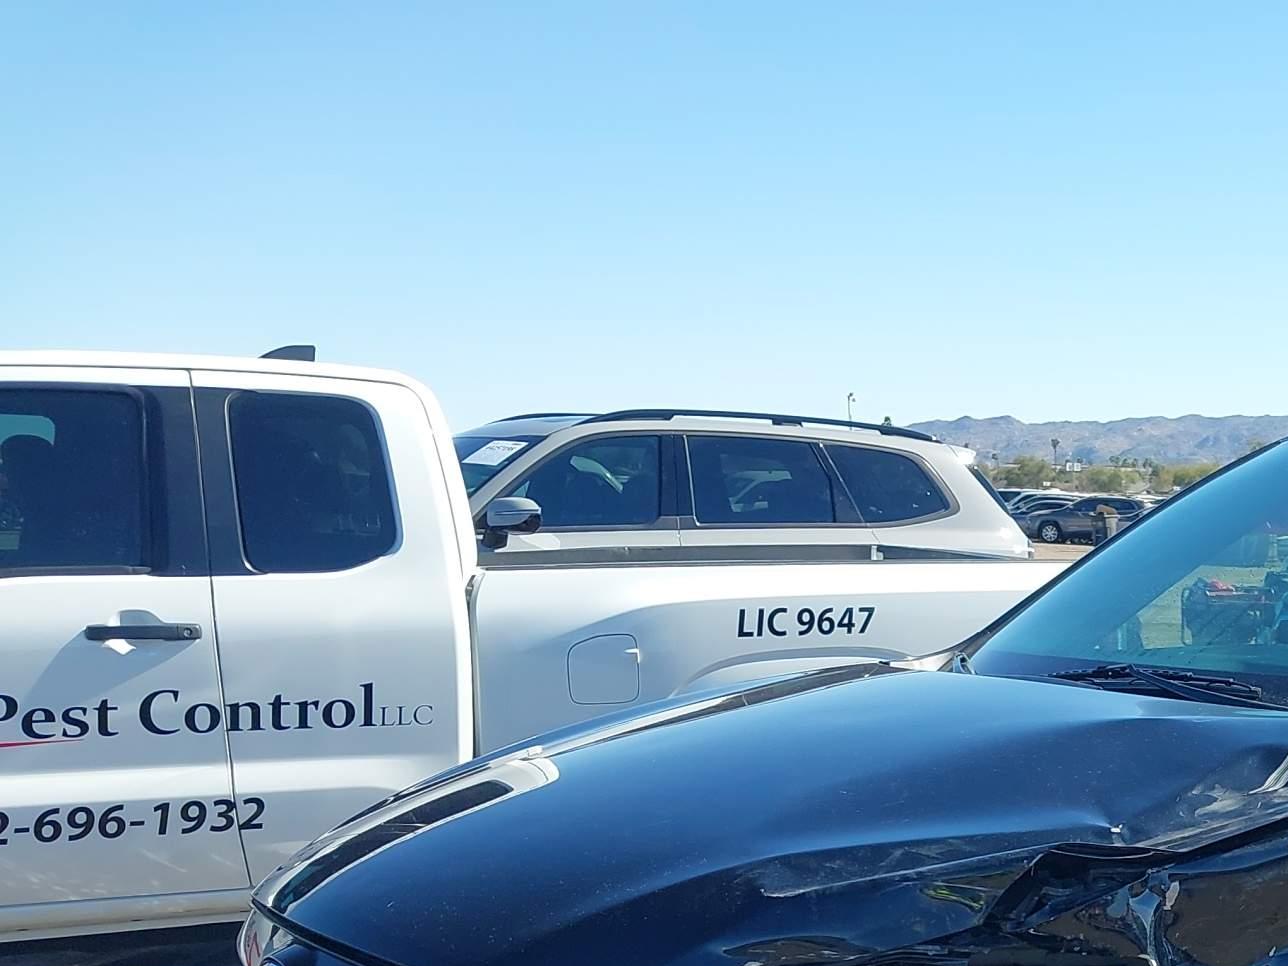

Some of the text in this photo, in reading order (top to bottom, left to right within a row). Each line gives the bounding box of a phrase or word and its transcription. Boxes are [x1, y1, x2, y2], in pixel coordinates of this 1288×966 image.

[737, 607, 875, 637] LIC 9647
[139, 682, 376, 735] Control
[379, 704, 434, 727] LLC
